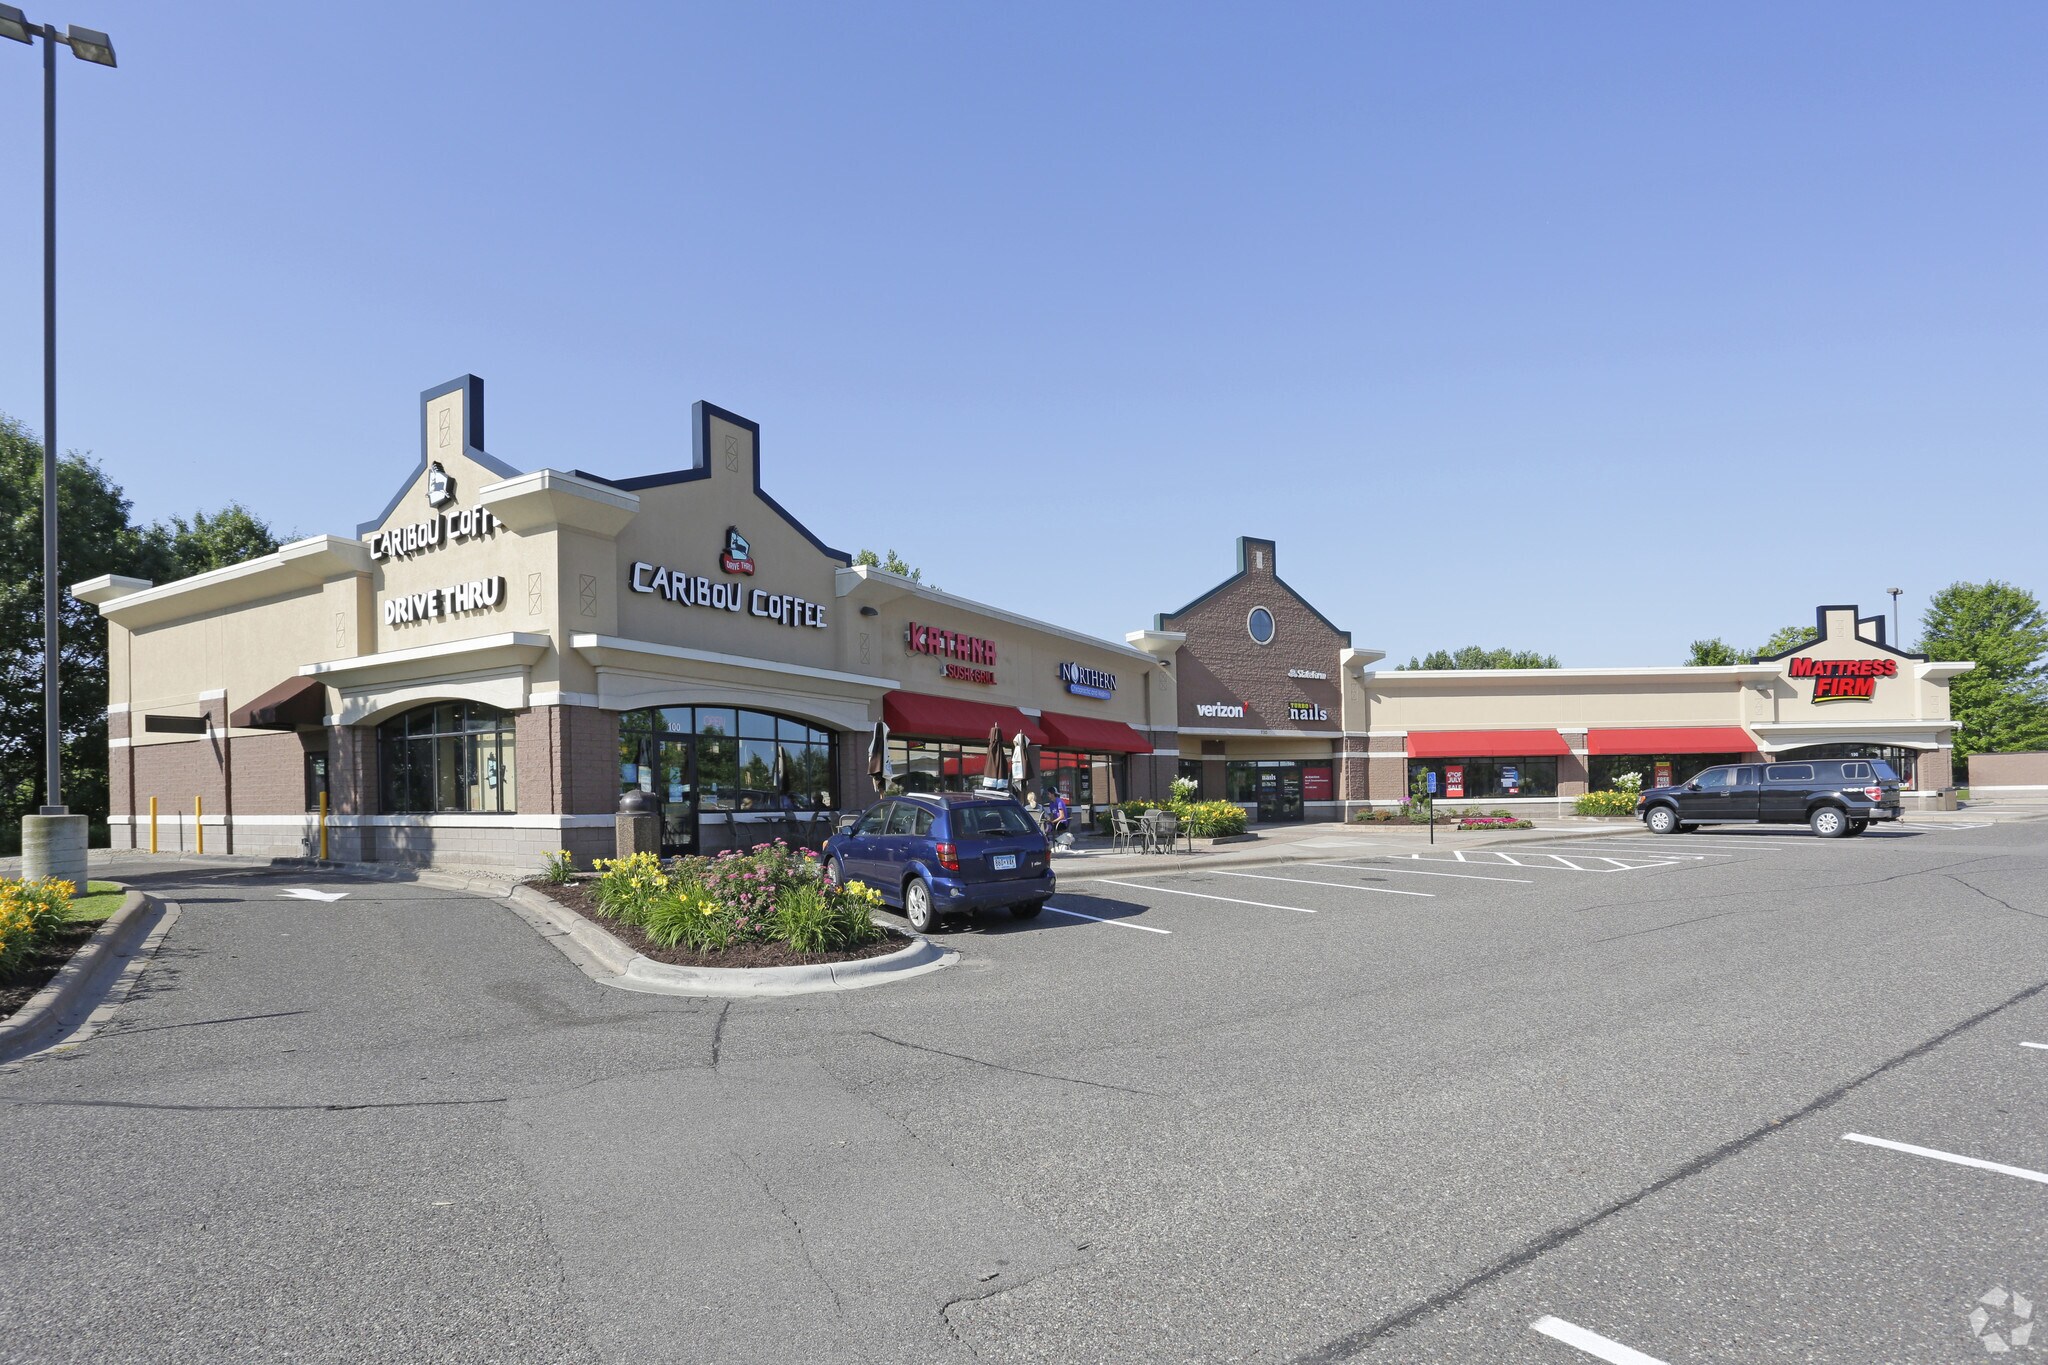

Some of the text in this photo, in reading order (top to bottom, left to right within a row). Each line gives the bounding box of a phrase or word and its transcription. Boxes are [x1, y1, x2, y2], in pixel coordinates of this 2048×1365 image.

[370, 513, 440, 560] CARIBOU
[726, 560, 753, 572] DRIVE THRU
[384, 575, 500, 626] DRIVE THRU
[633, 561, 828, 628] CARIBOU COFFEE
[909, 621, 997, 666] KATANA
[1062, 661, 1117, 691] NORTHERN
[1790, 657, 1897, 677] MATTRESS
[1815, 677, 1876, 697] FIRM
[1196, 701, 1244, 718] verizon
[1290, 703, 1328, 721] nails
[667, 722, 681, 732] 100
